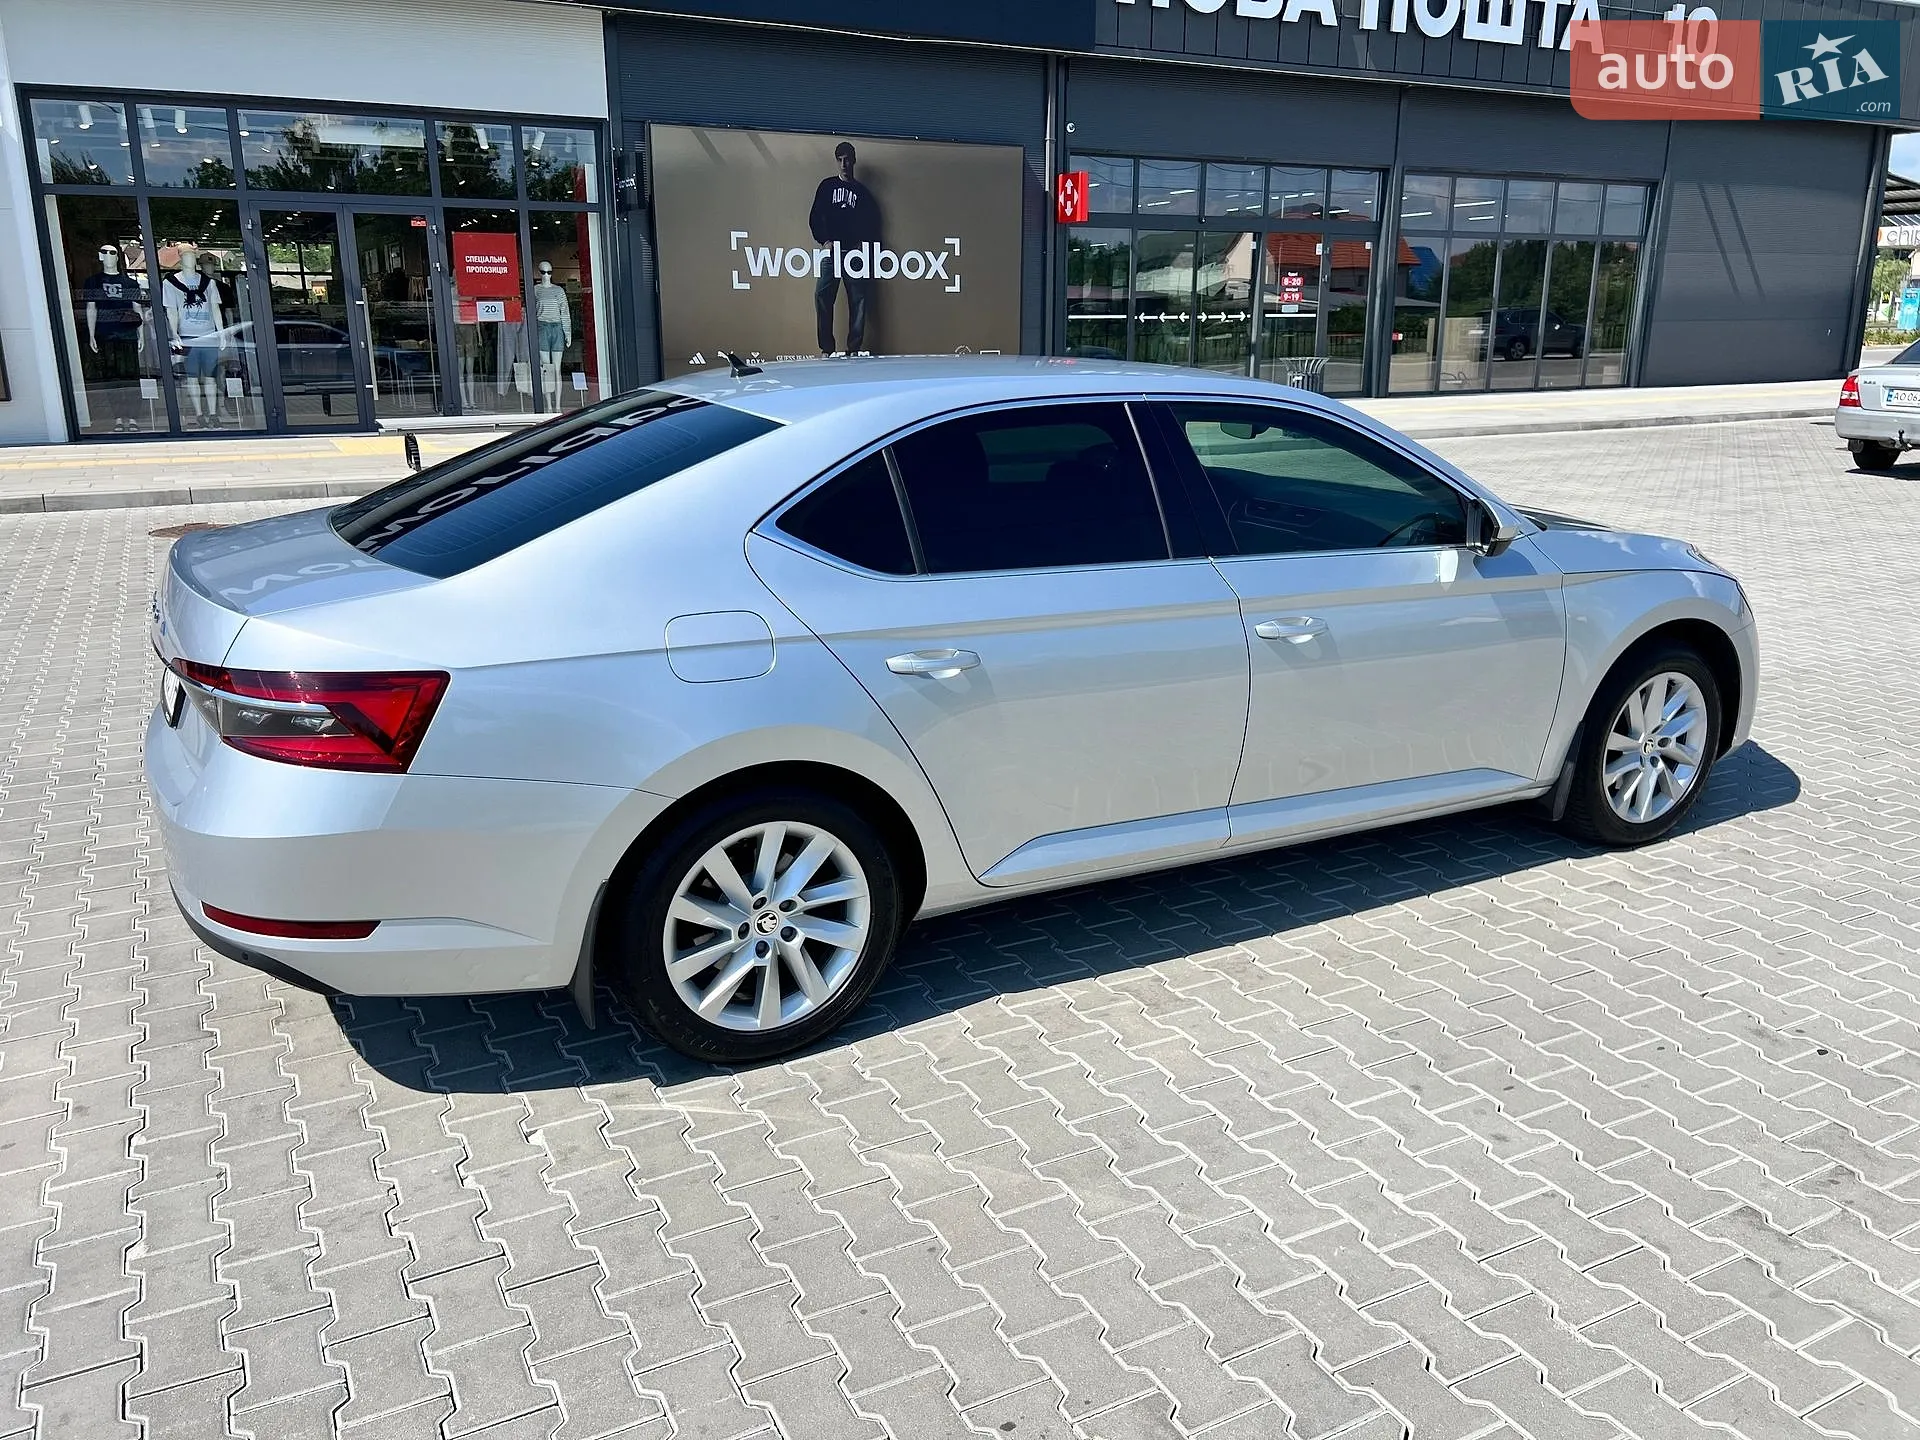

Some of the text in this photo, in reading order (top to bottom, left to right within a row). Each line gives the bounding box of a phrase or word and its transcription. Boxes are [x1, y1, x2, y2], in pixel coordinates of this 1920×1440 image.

[1663, 3, 1719, 66] 10
[465, 256, 507, 264] СПЕЦІАЛЬНА
[466, 266, 508, 274] ПРОПОЗИЦІЯ
[743, 240, 950, 280] worldbox
